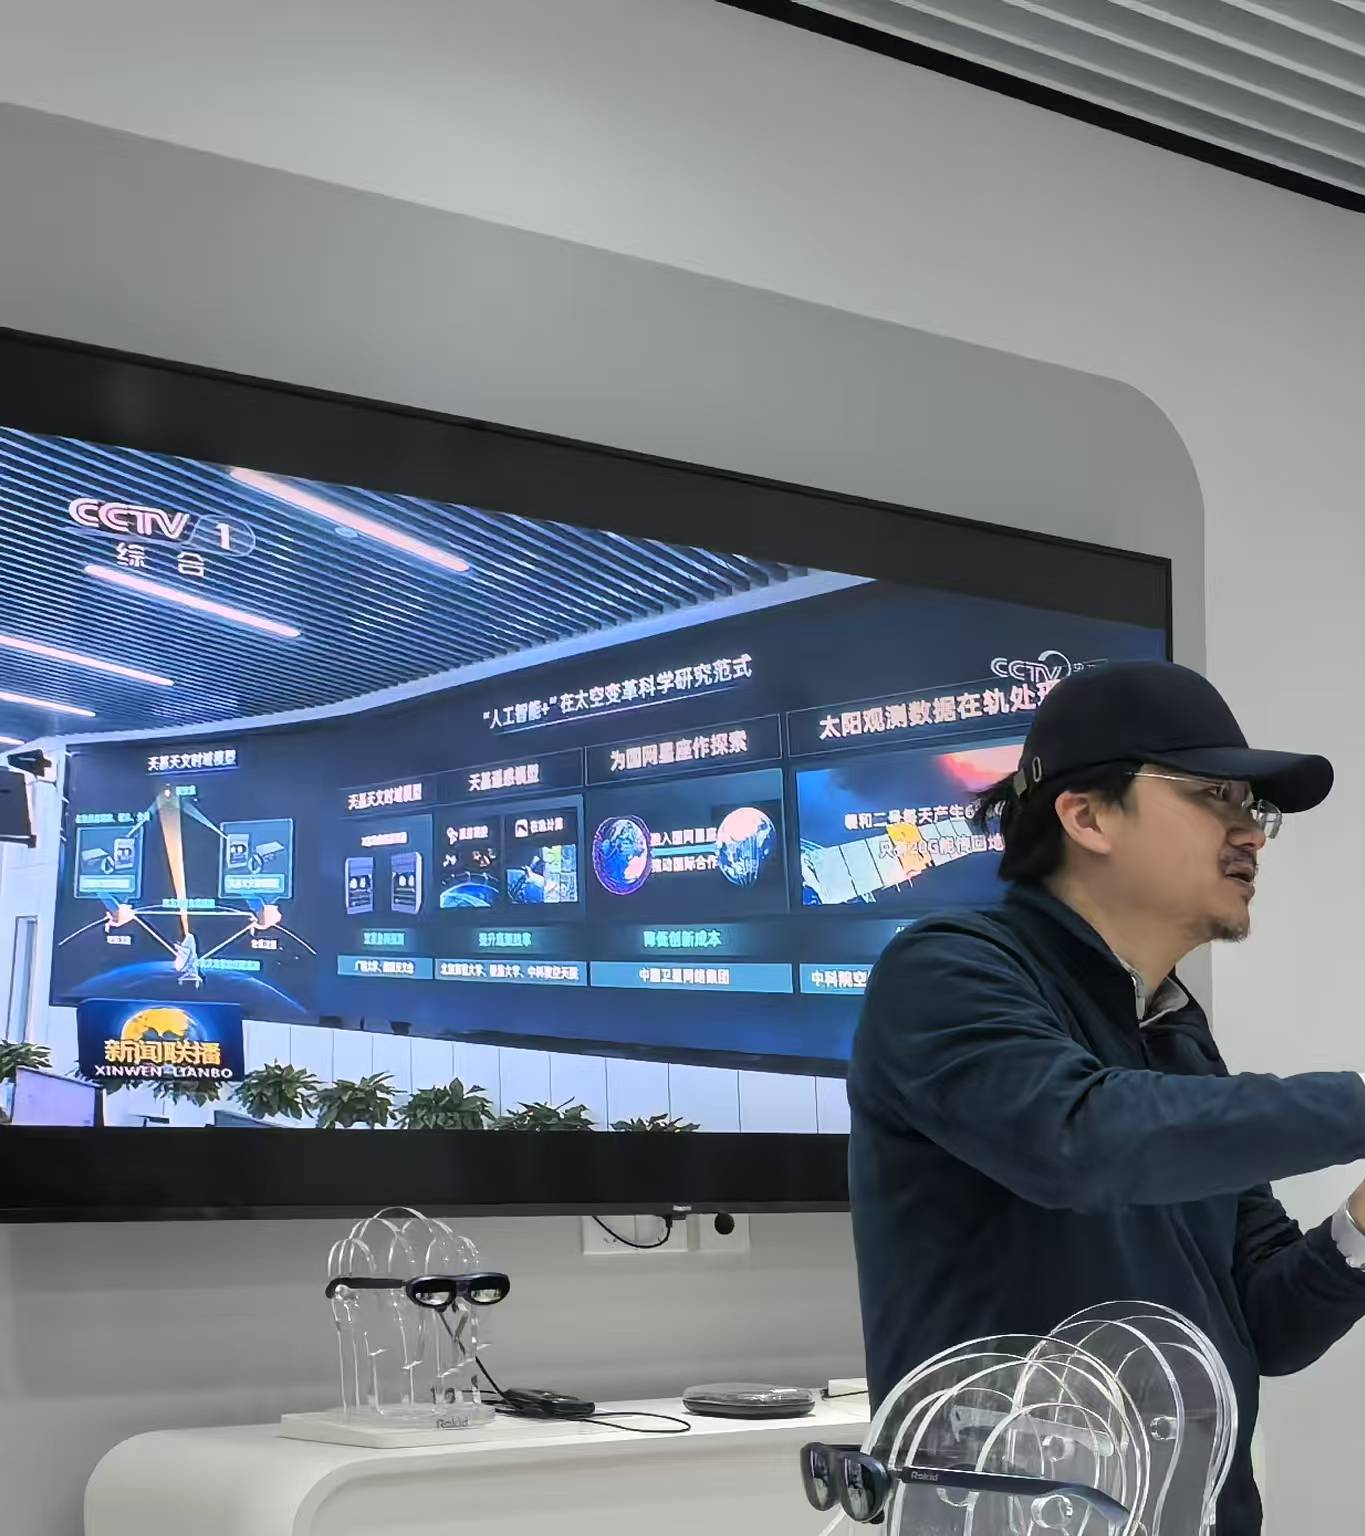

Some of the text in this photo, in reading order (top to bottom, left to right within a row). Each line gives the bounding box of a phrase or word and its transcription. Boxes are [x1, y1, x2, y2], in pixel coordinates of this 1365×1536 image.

[68, 497, 232, 550] CCTV 1
[104, 1039, 221, 1065] 新闻联播
